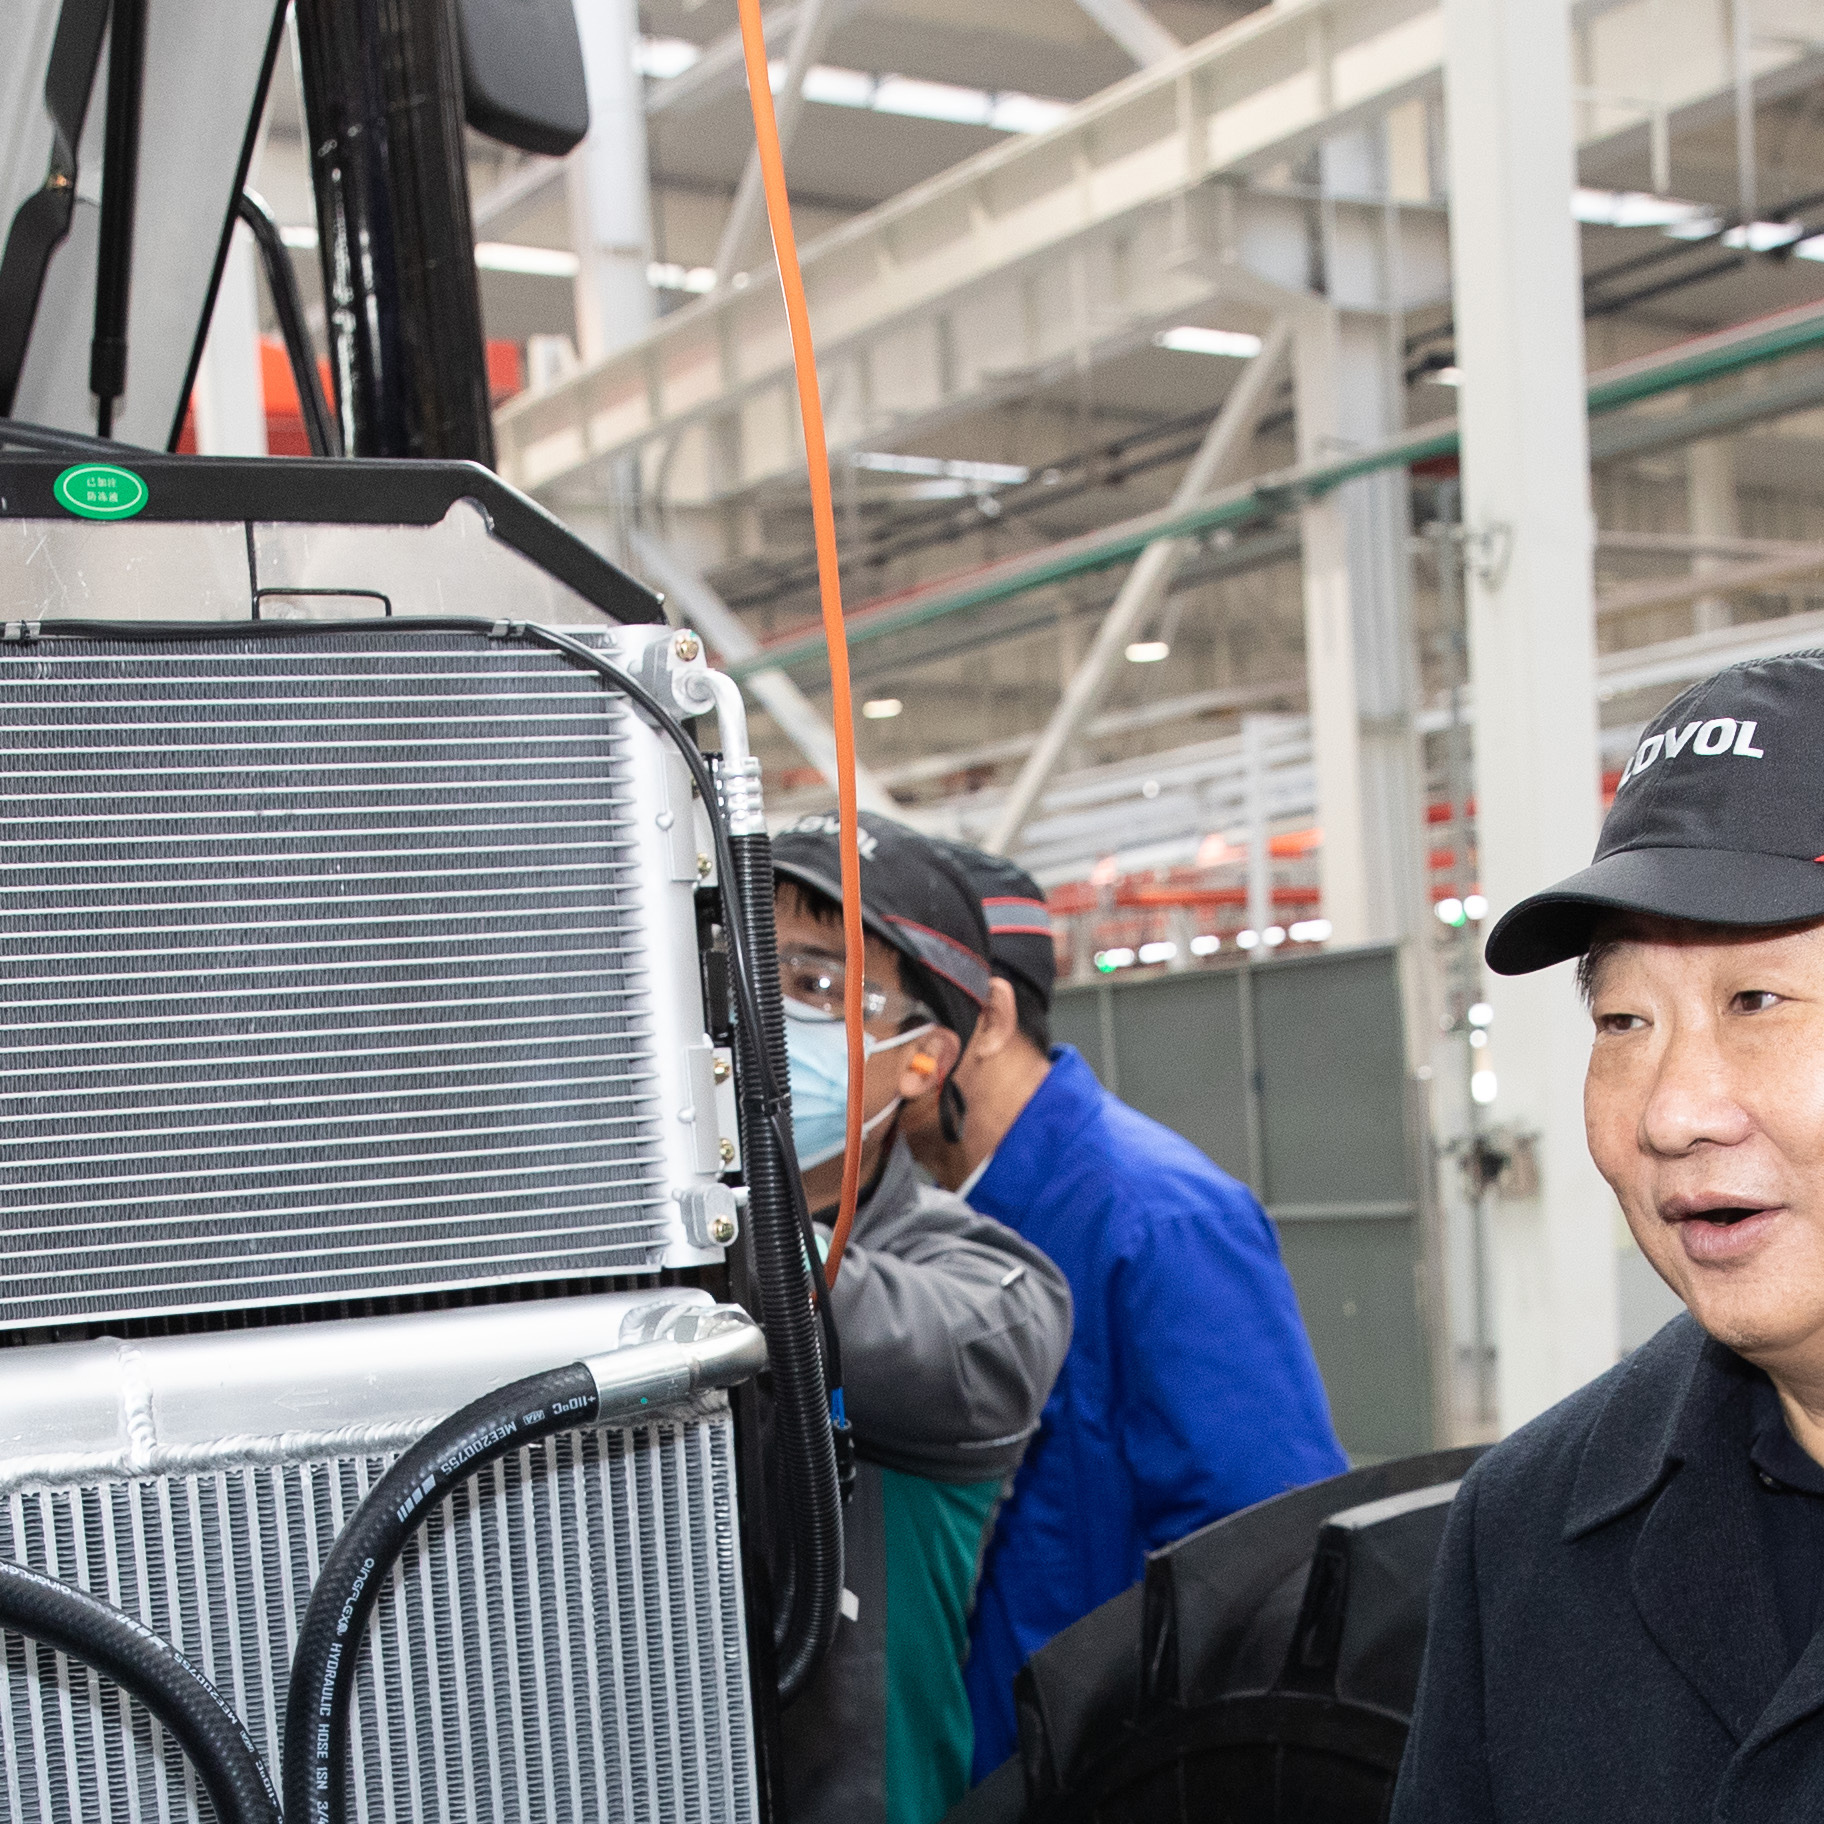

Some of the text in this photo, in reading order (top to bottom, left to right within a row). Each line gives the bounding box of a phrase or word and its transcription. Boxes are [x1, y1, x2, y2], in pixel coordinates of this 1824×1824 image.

[1617, 717, 1764, 791] LOVOL
[319, 1642, 343, 1717] HYDRAULIC
[316, 1723, 330, 1759] HOSE
